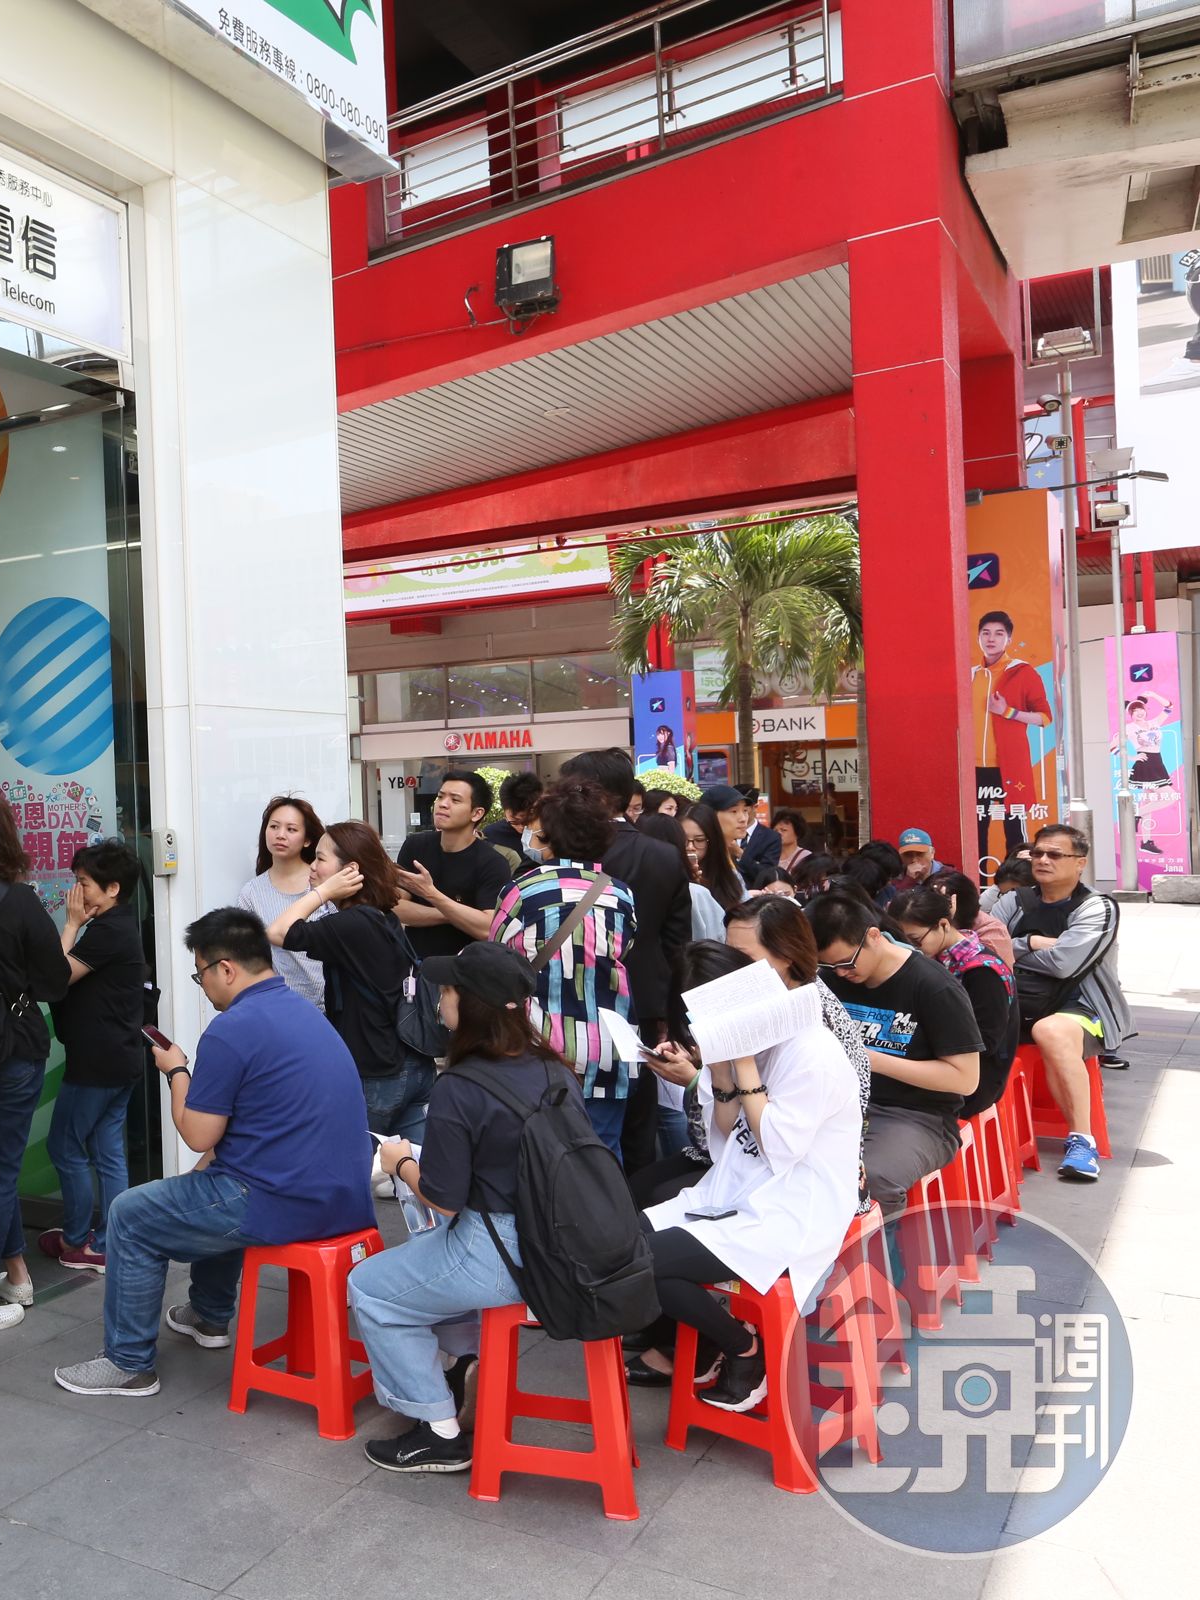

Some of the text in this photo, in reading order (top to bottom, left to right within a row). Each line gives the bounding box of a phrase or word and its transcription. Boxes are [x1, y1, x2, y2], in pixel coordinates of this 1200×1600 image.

[1, 277, 56, 314] Telecom
[463, 729, 532, 750] YAMAHA
[978, 786, 1007, 799] me
[47, 803, 87, 812] MOTHER'S
[48, 811, 87, 829] DAY
